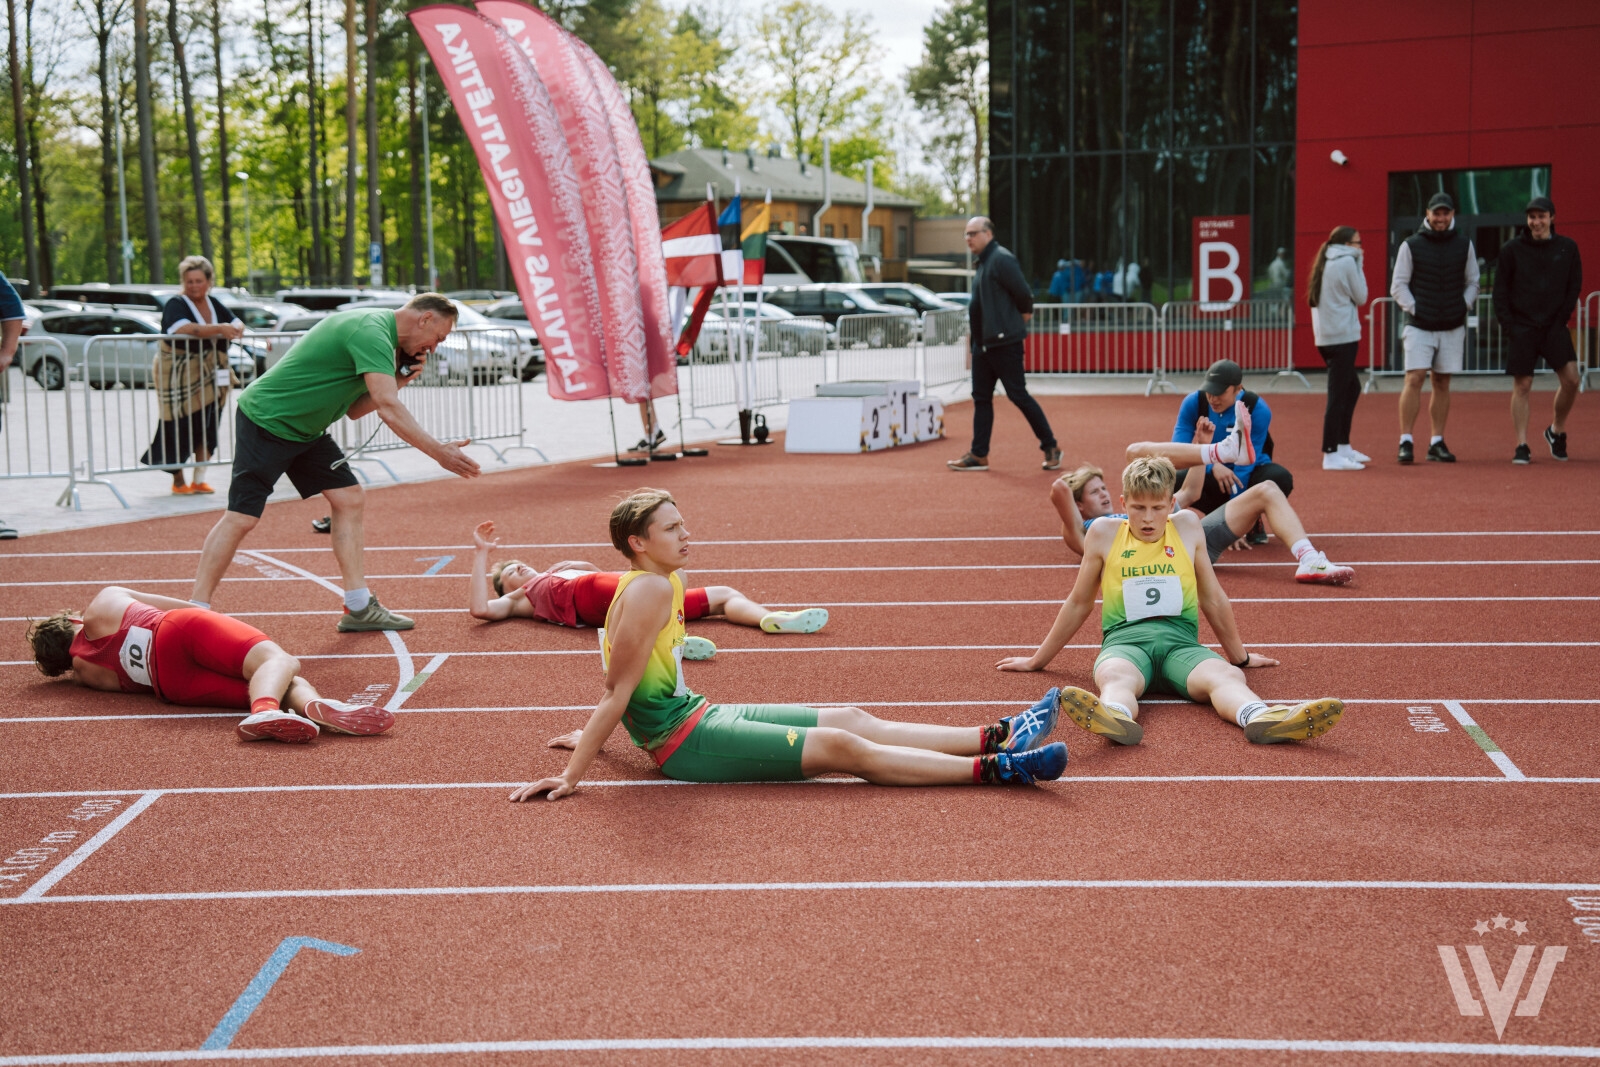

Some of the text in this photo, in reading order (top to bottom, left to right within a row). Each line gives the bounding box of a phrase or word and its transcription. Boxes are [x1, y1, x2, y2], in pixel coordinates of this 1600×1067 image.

[1199, 241, 1243, 312] B
[872, 407, 879, 439] 2
[902, 391, 907, 435] 1
[928, 404, 934, 435] 3
[1121, 563, 1176, 578] LIETUVA
[1145, 587, 1161, 606] 9
[129, 643, 144, 670] 10
